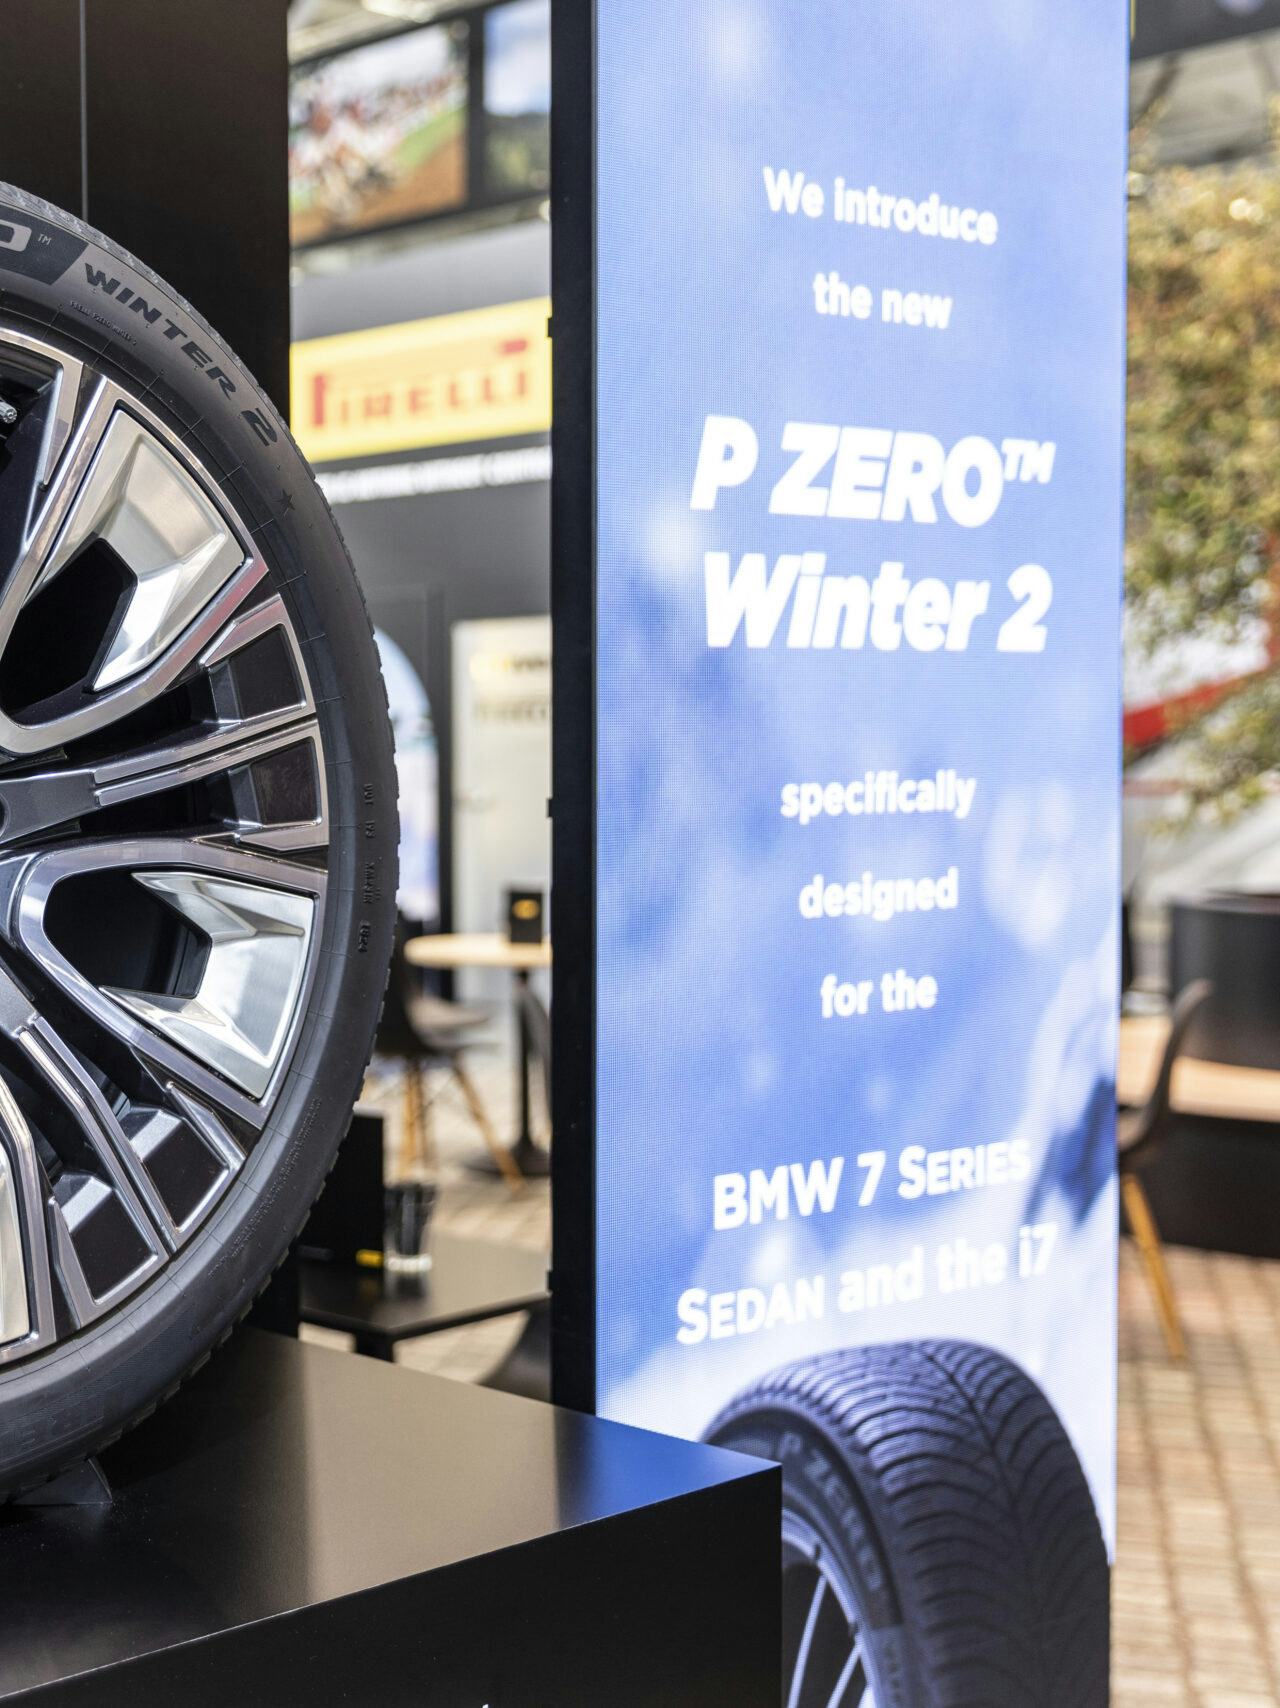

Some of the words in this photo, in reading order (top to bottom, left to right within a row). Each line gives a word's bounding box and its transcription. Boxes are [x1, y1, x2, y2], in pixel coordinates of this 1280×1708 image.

[763, 166, 824, 217] We
[833, 176, 999, 244] introduce
[812, 271, 872, 320] the
[881, 287, 954, 329] new
[84, 262, 237, 401] WINTER
[240, 407, 278, 447] 2
[689, 415, 759, 511] P
[703, 551, 991, 652] Winter
[996, 562, 1054, 653] 2
[780, 769, 977, 825] specifically
[798, 867, 960, 921] designed
[820, 973, 873, 1018] for
[880, 969, 938, 1013] the
[712, 1155, 845, 1230] BMW
[856, 1150, 887, 1208] 7
[838, 1242, 923, 1313] and
[935, 1238, 1009, 1296] the
[1018, 1221, 1059, 1279] i7
